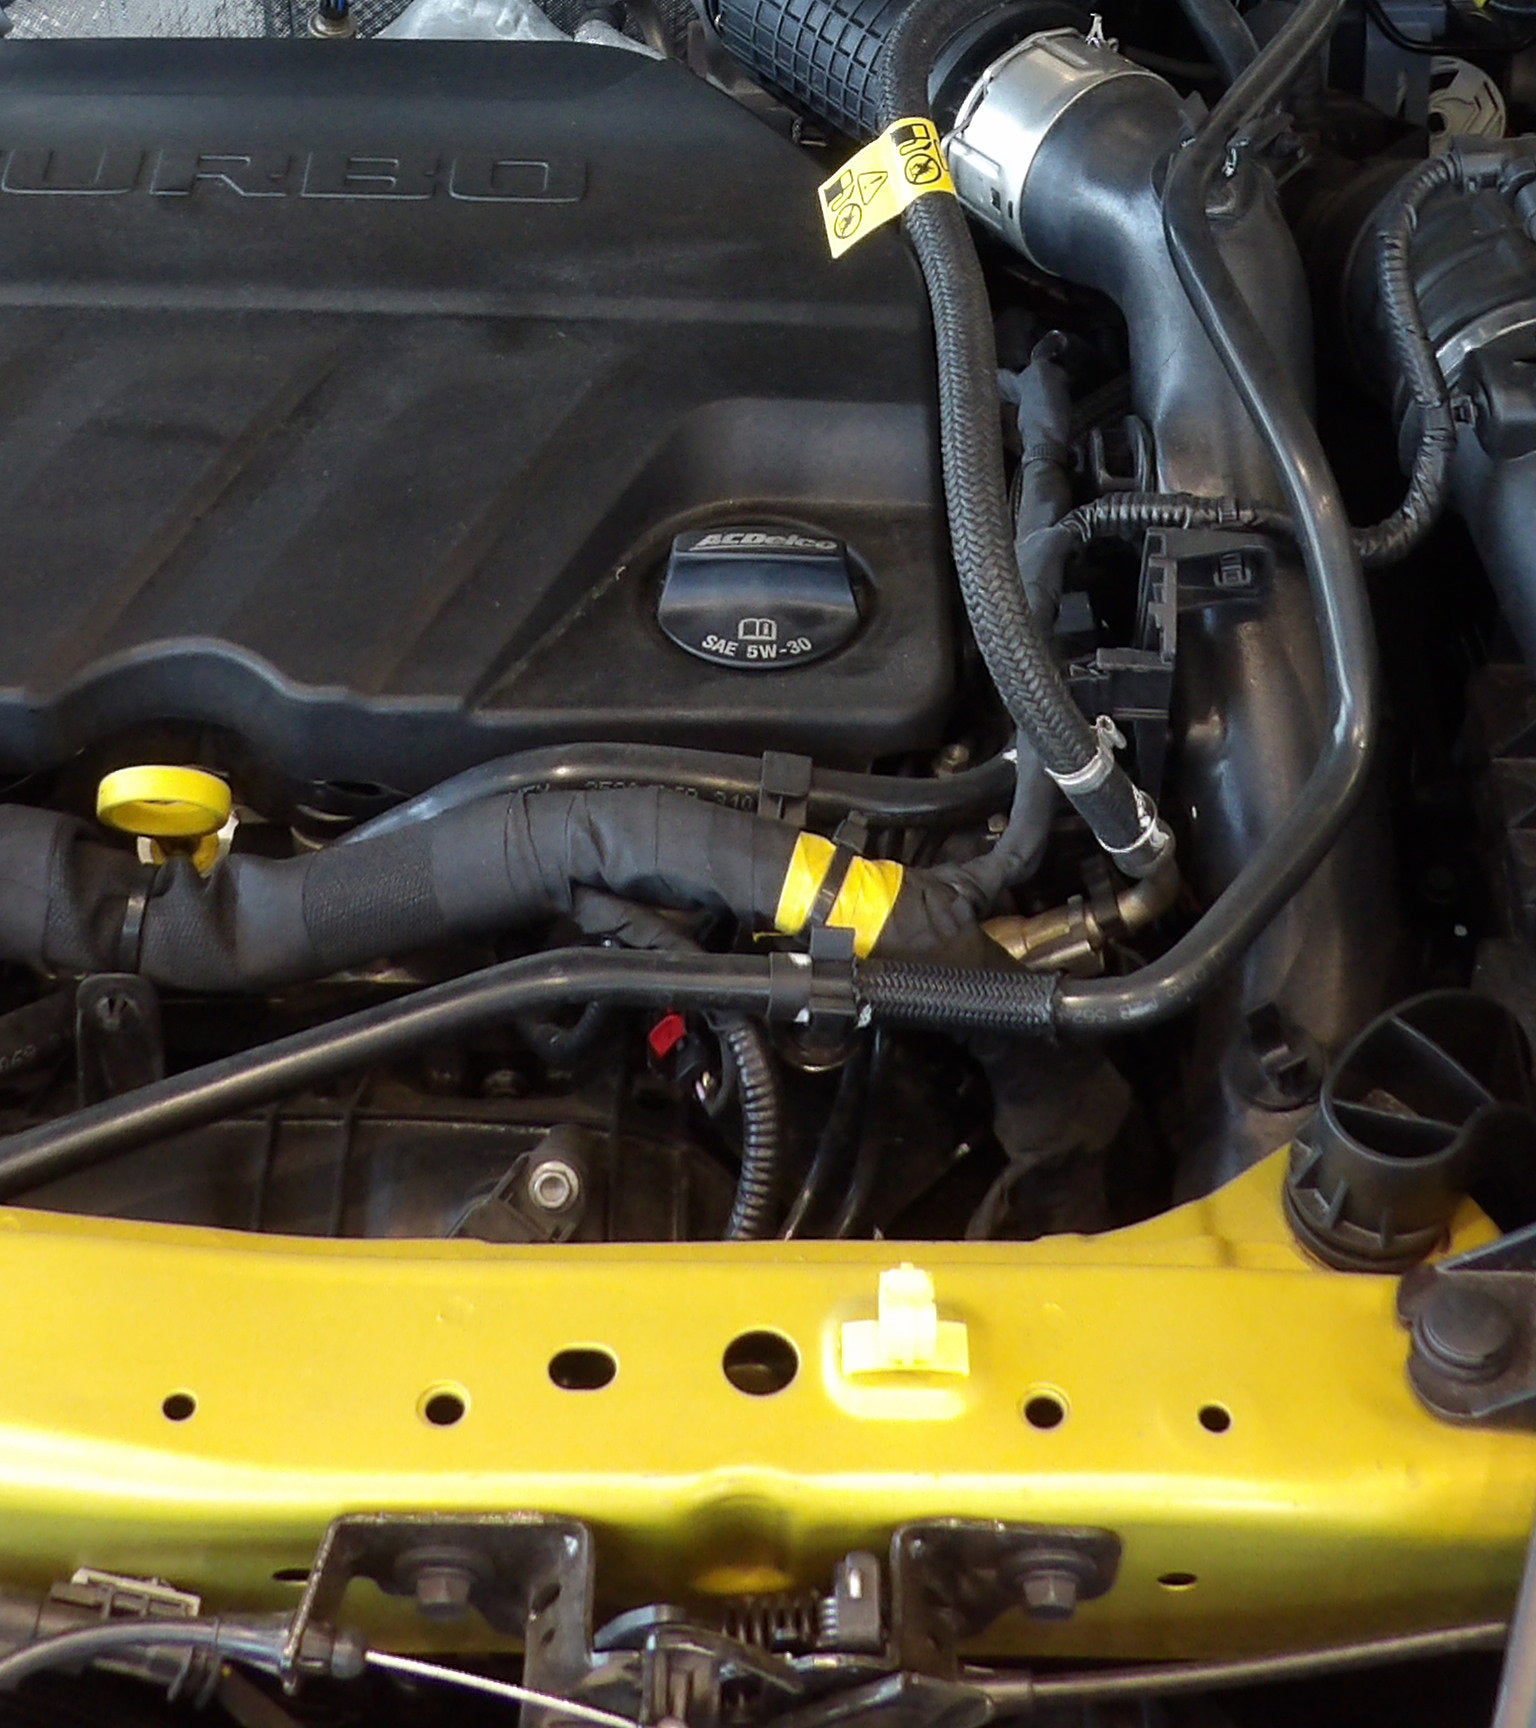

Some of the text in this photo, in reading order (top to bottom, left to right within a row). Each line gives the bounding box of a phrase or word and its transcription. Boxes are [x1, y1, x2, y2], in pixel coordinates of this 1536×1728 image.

[694, 532, 838, 552] ACDelco
[701, 633, 813, 660] SAE 5W-30
